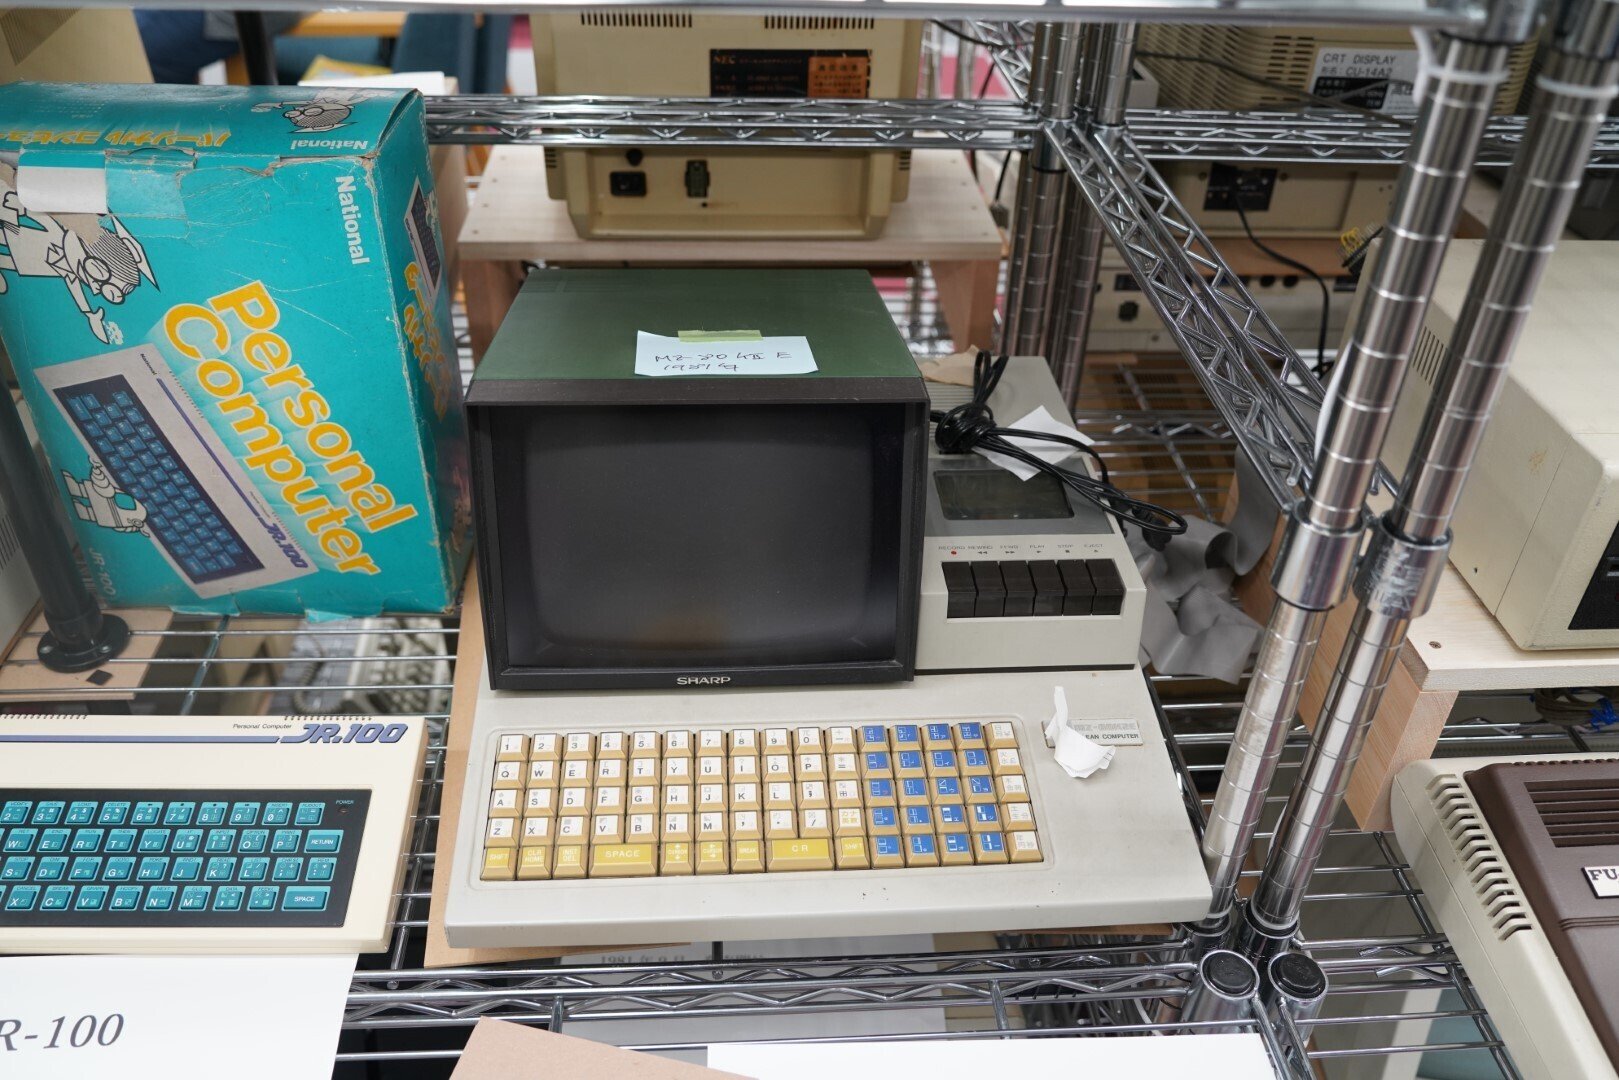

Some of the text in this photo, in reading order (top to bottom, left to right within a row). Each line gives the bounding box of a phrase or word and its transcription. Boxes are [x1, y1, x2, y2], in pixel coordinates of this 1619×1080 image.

[1323, 53, 1396, 65] CRT DISPLAY
[290, 139, 368, 150] National
[335, 176, 370, 264] National
[207, 280, 418, 533] Personal
[163, 303, 381, 576] Computer
[677, 676, 731, 685] SHARP
[10, 898, 19, 906] X
[46, 898, 53, 906] C
